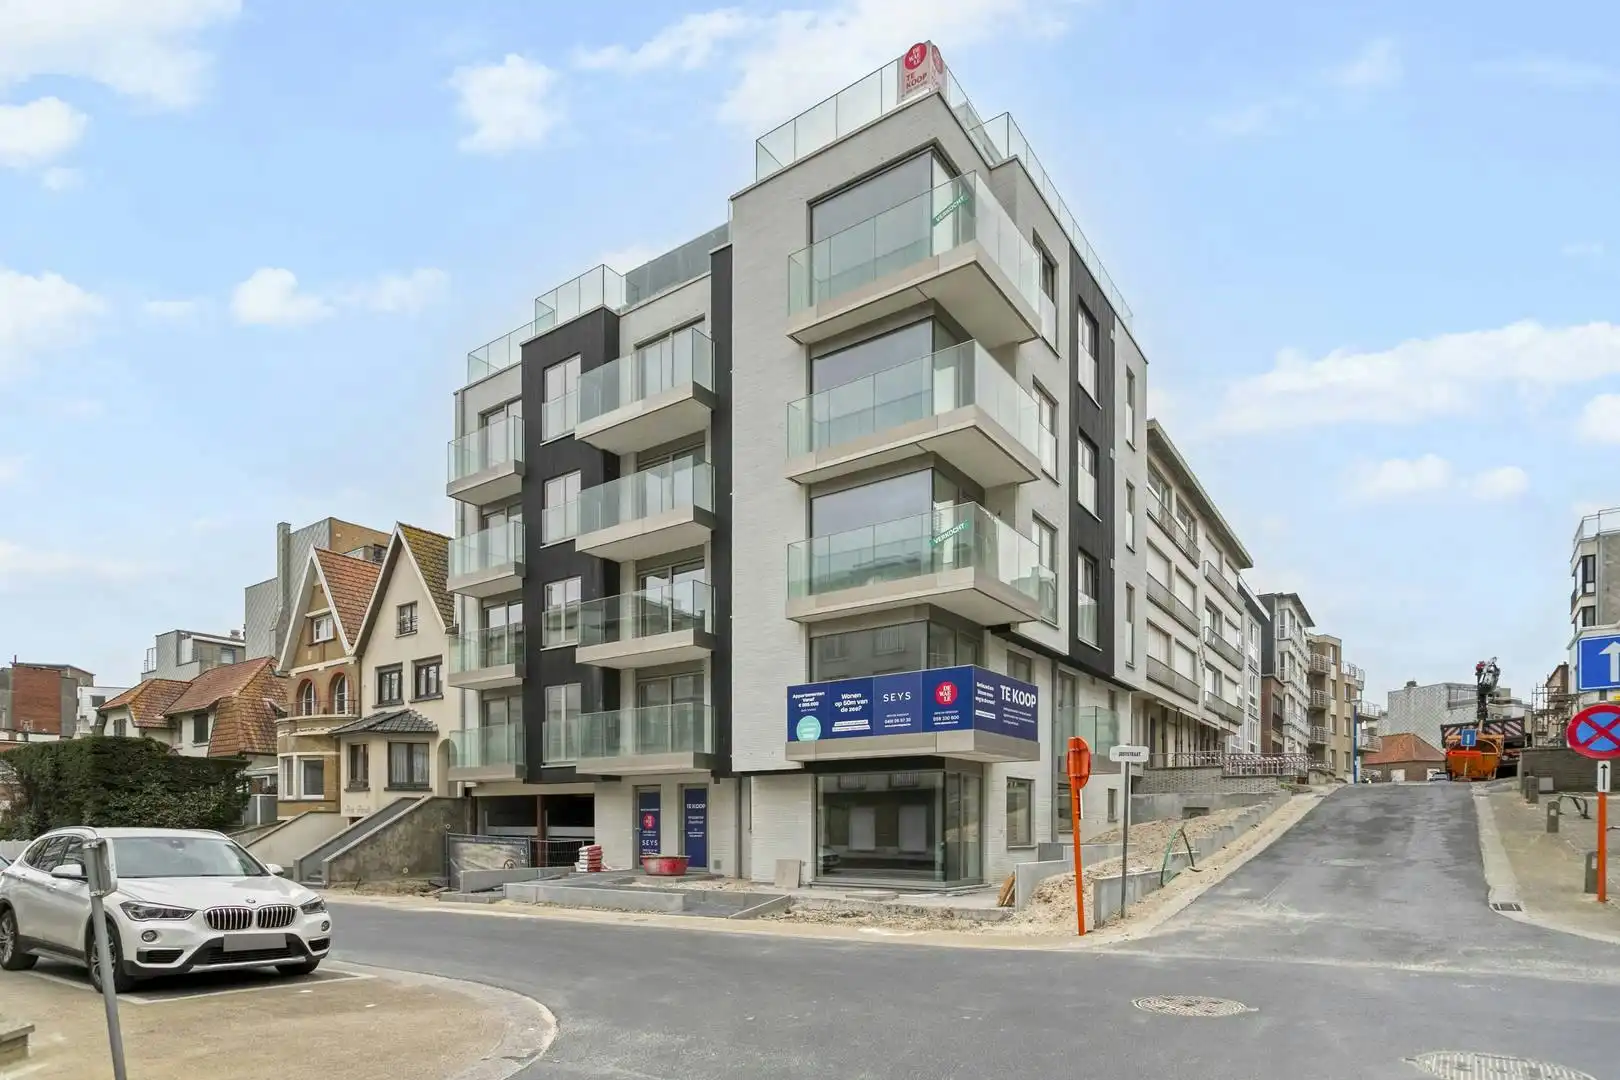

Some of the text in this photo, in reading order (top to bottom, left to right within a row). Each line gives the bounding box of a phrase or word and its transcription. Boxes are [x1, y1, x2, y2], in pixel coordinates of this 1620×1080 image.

[906, 72, 928, 89] KOOP
[933, 521, 965, 544] VERKOCHT
[883, 691, 911, 702] SEYS
[1000, 684, 1011, 702] TE
[1012, 688, 1037, 709] KOOP
